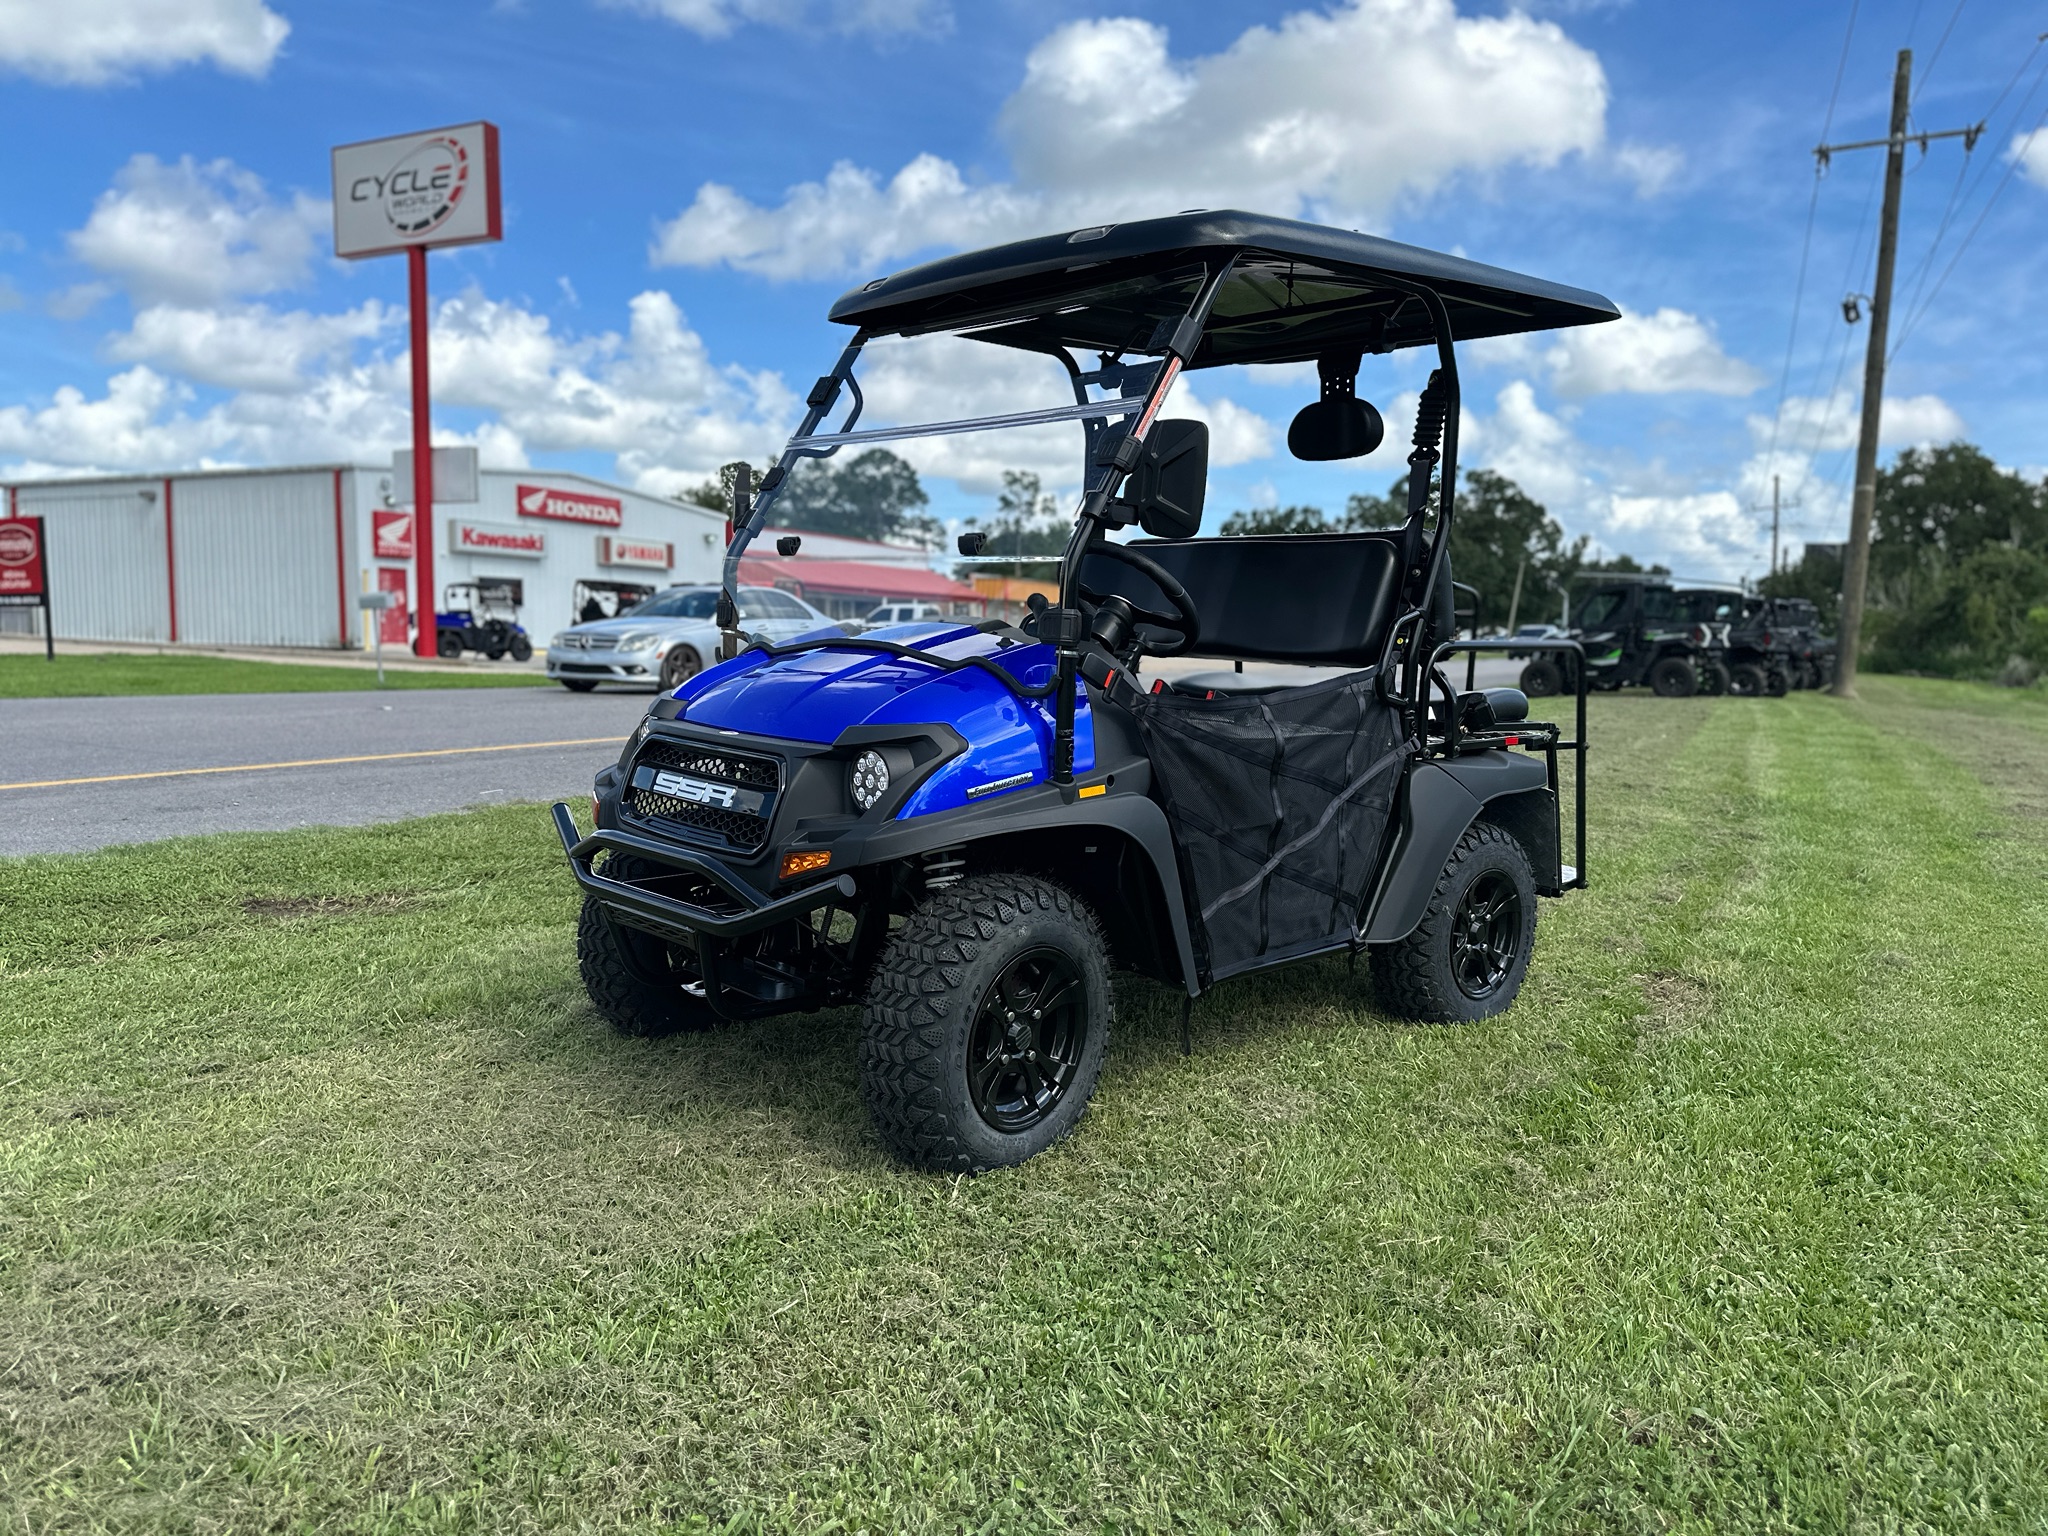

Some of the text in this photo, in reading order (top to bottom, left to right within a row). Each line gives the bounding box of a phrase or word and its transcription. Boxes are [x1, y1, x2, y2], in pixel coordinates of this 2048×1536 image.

[351, 165, 452, 202] CYCLE
[392, 192, 444, 208] WORLD
[546, 500, 620, 523] HONDA
[462, 528, 543, 551] Kawasaki
[654, 773, 737, 807] SSR
[954, 983, 982, 1072] DURO
